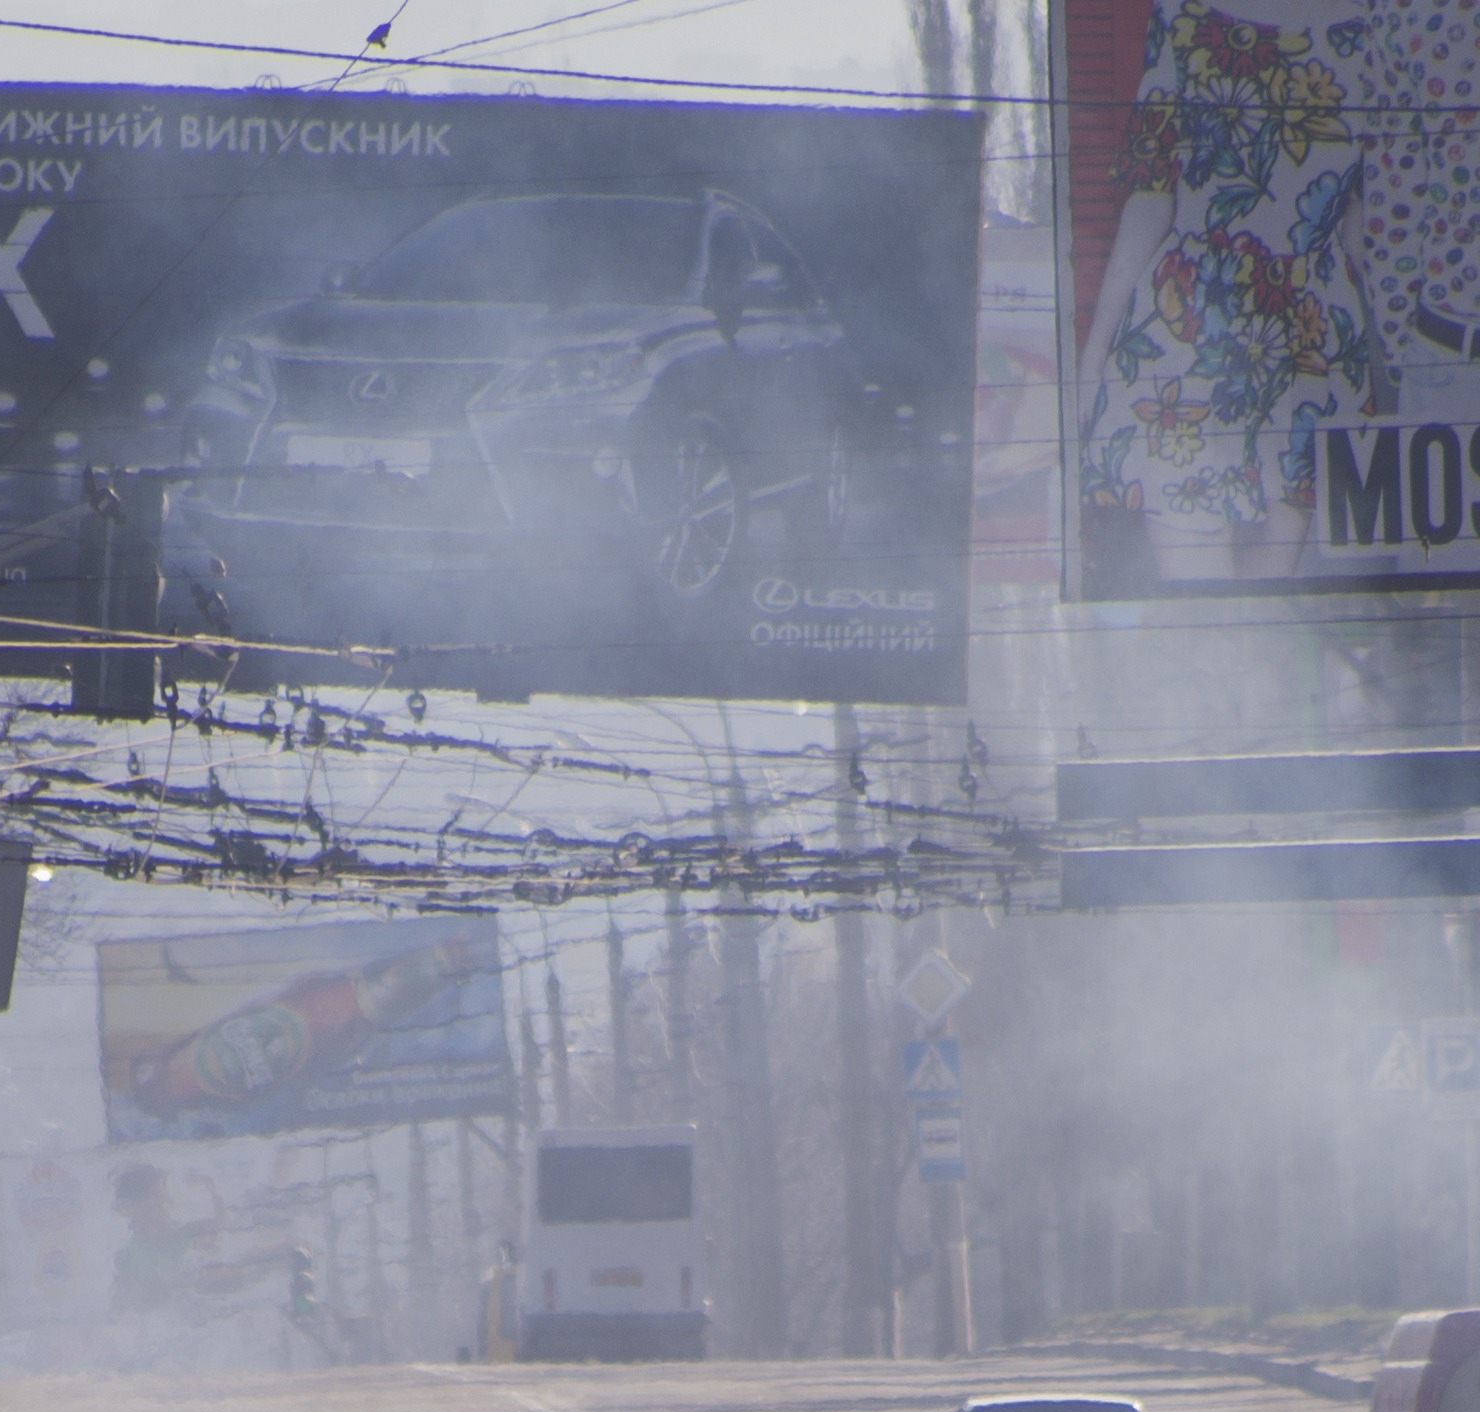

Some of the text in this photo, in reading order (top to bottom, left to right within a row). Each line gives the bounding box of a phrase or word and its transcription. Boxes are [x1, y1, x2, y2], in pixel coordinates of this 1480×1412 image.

[181, 114, 452, 157] ВИПУСКНИК
[804, 589, 936, 612] LEXUS
[750, 617, 935, 653] ОФІЦІЙНИЙ
